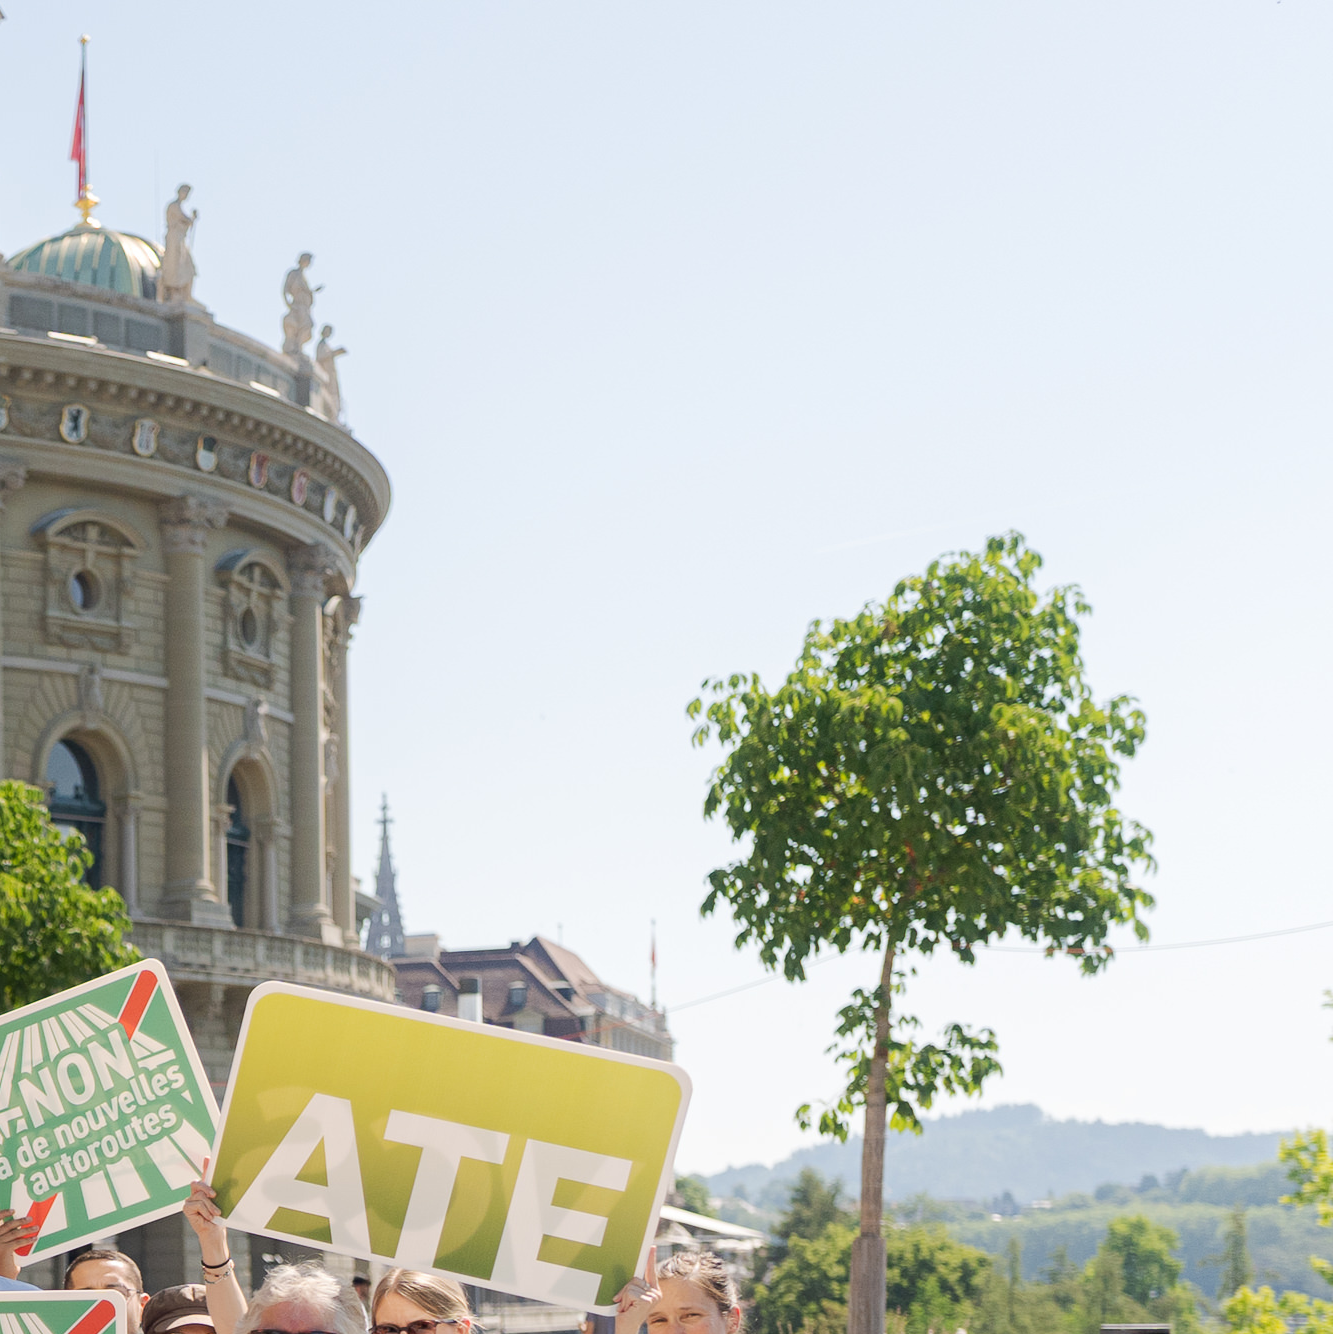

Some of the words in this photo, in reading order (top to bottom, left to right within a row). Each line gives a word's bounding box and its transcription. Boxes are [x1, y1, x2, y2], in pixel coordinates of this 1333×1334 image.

[17, 1135, 51, 1168] de
[53, 1065, 185, 1149] nouvelles
[18, 1028, 135, 1128] NON
[30, 1104, 177, 1195] autoroutes
[226, 1092, 633, 1306] ATE
